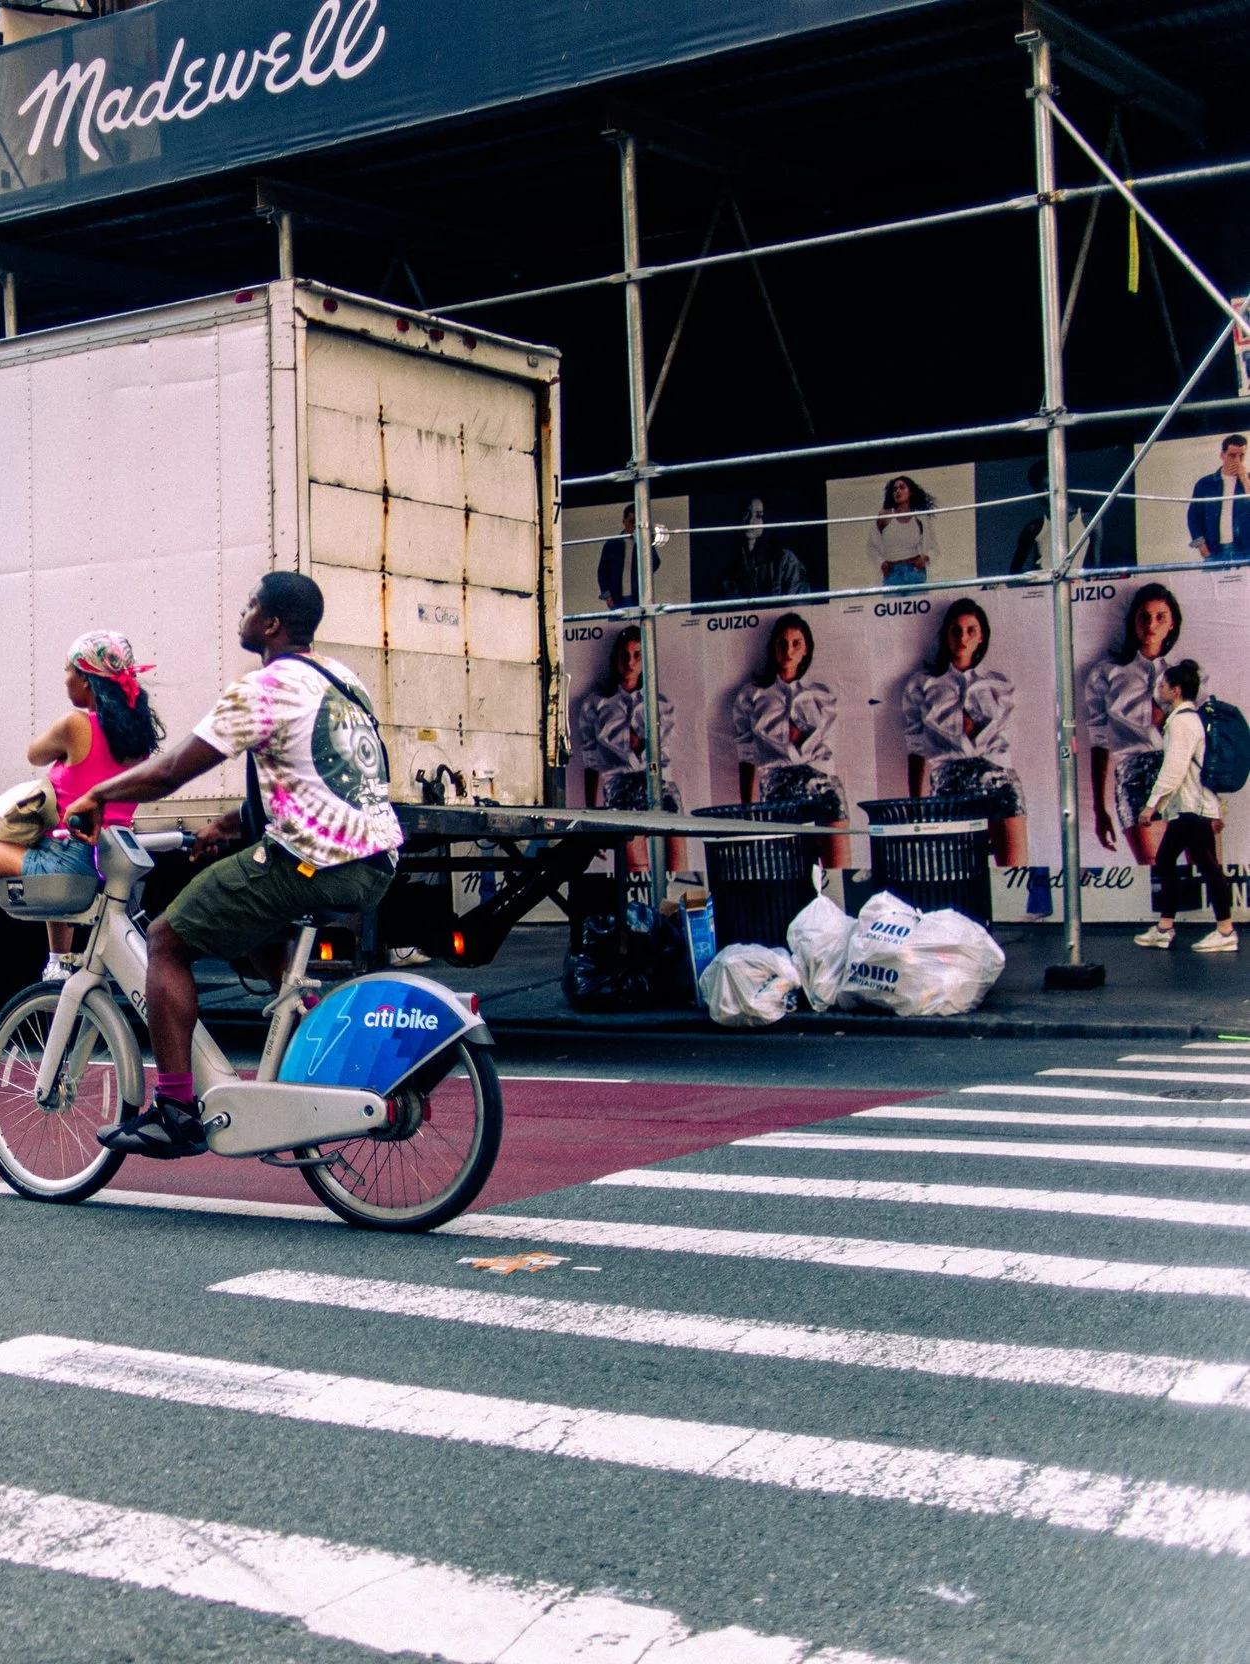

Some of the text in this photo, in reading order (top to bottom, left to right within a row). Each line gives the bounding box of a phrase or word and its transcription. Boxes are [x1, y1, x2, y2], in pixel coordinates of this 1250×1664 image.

[17, 0, 386, 162] Madewell
[1071, 585, 1116, 602] UIZIO
[873, 599, 931, 617] GUIZIO
[707, 614, 760, 632] GUIZIO
[563, 626, 604, 642] UIZIO
[870, 921, 910, 938] OHO
